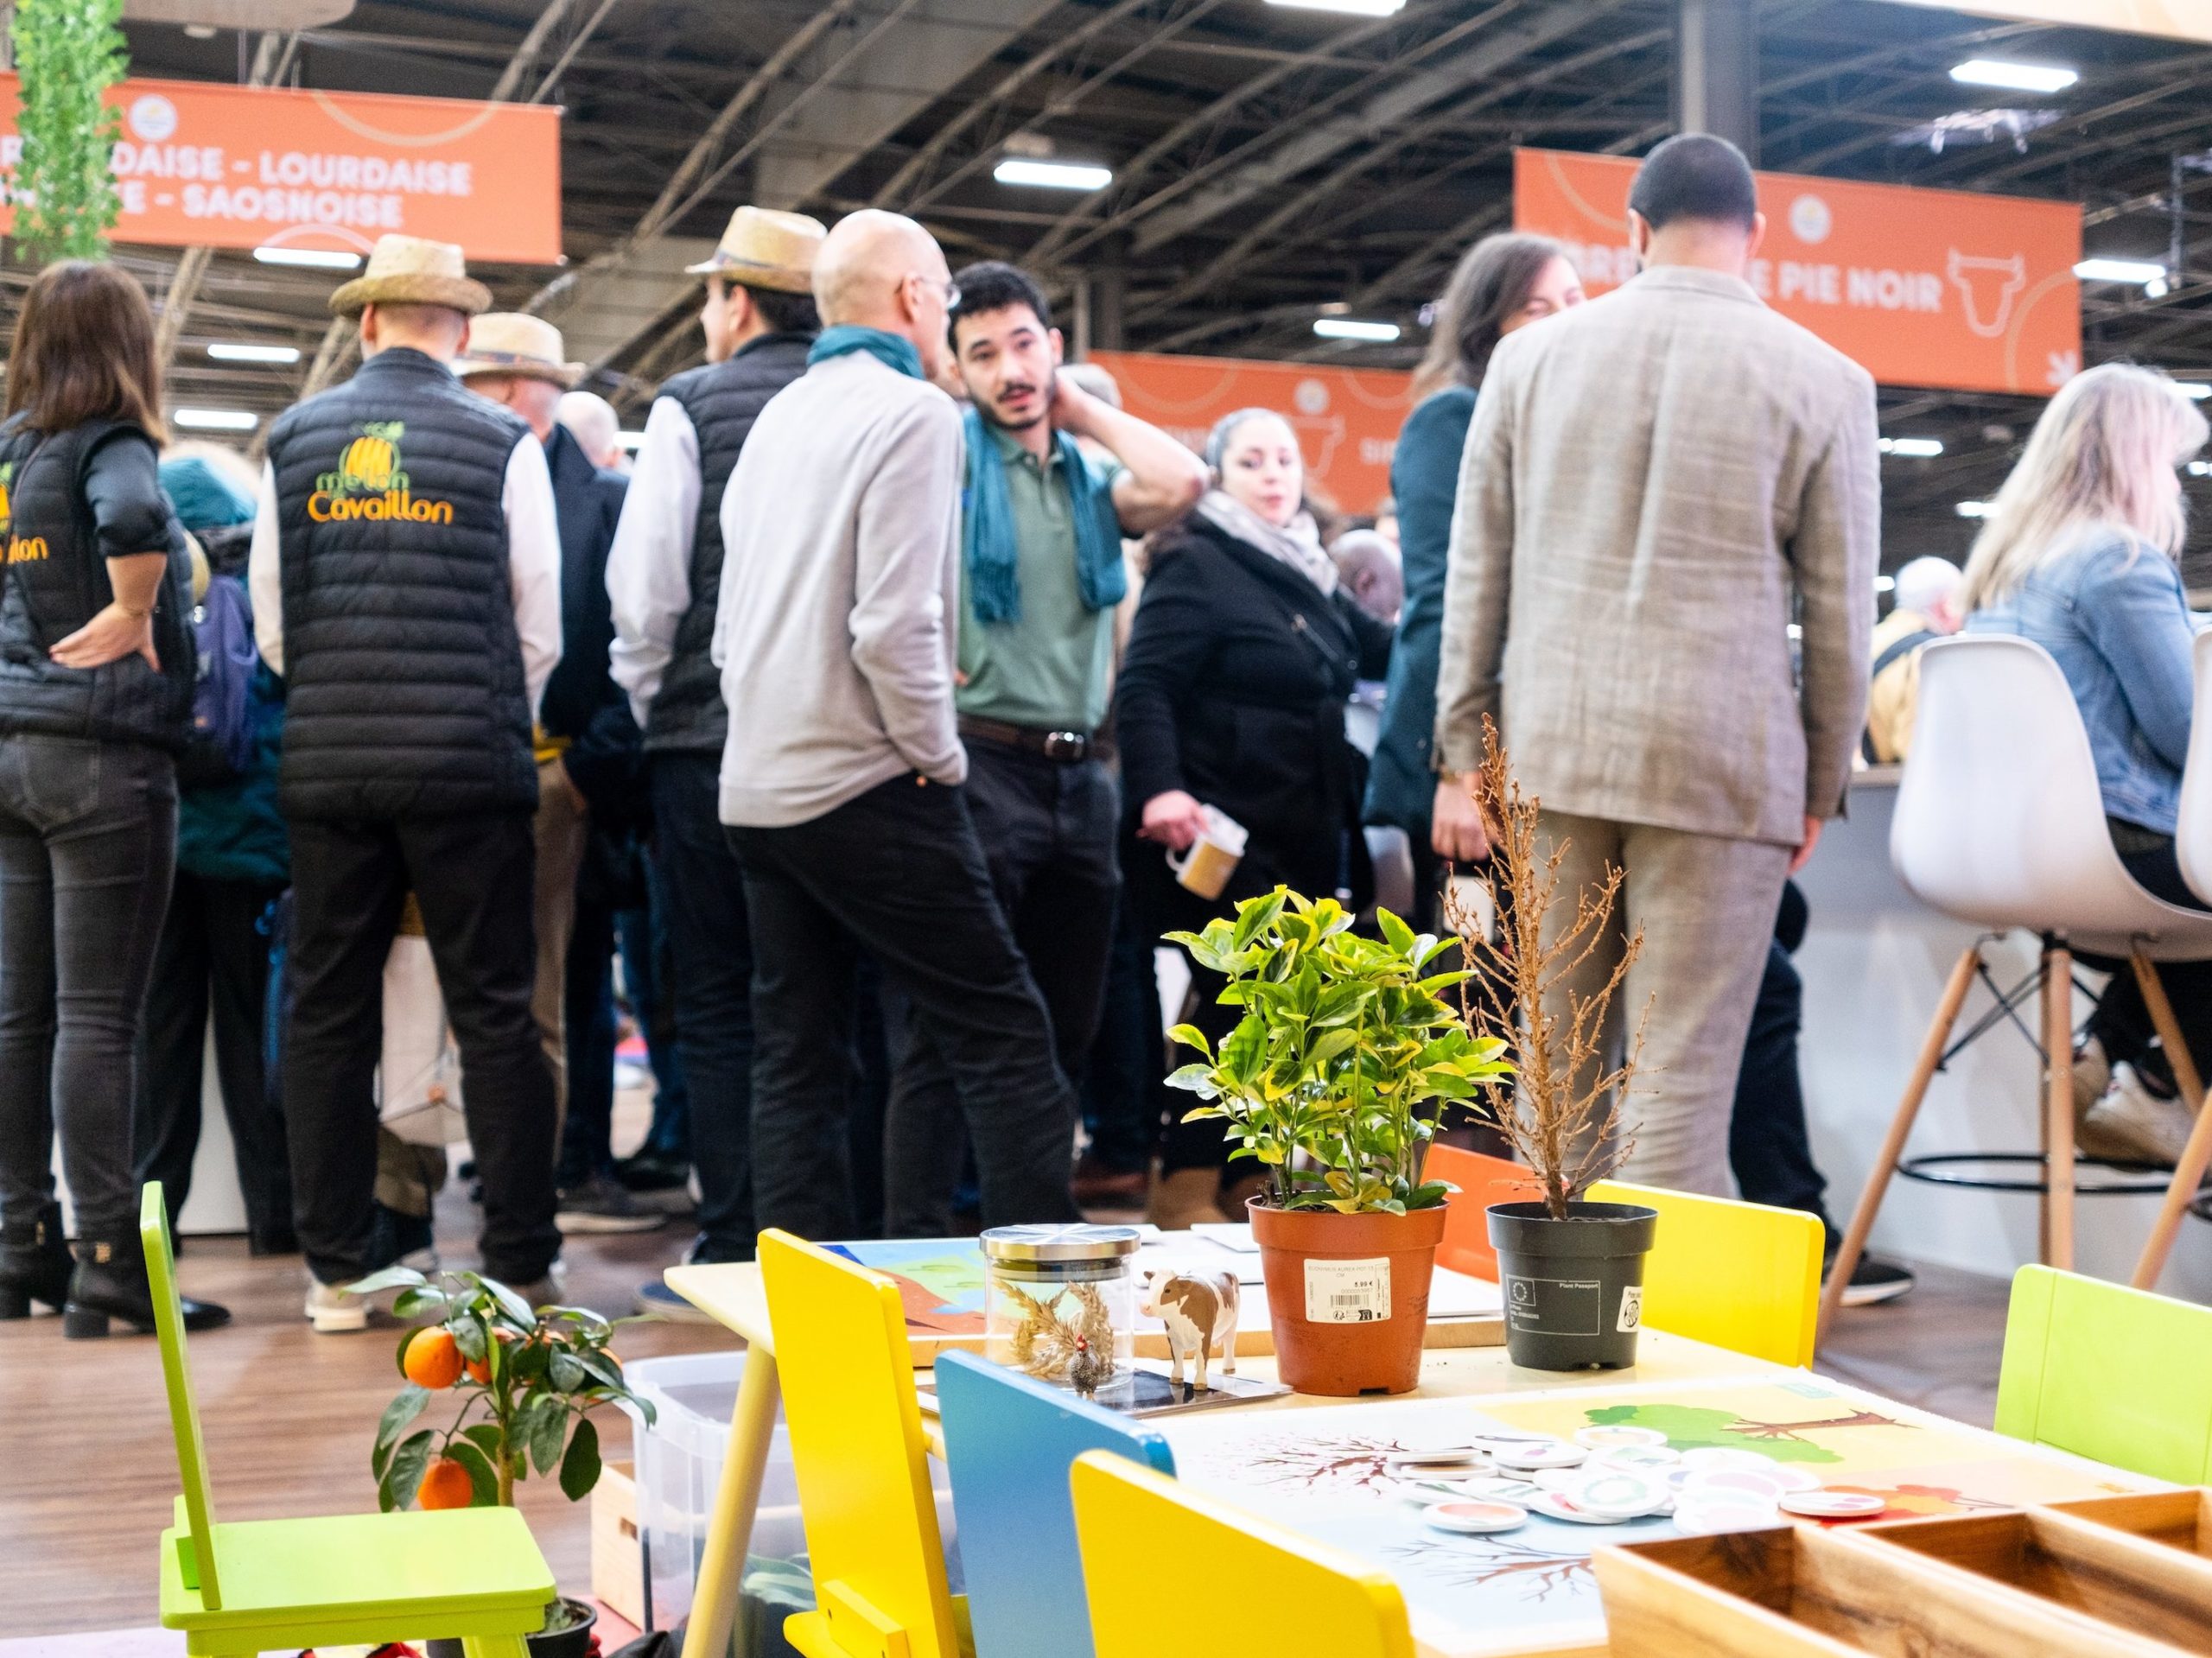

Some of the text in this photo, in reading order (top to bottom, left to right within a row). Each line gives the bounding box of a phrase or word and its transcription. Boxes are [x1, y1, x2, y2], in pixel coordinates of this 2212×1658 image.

[260, 150, 472, 197] LOURDAISE
[182, 182, 404, 228] SAOSNOISE
[1779, 261, 1840, 305] PIE
[1847, 266, 1942, 313] NOIR
[316, 472, 410, 492] melon
[308, 489, 454, 524] Cavaillon
